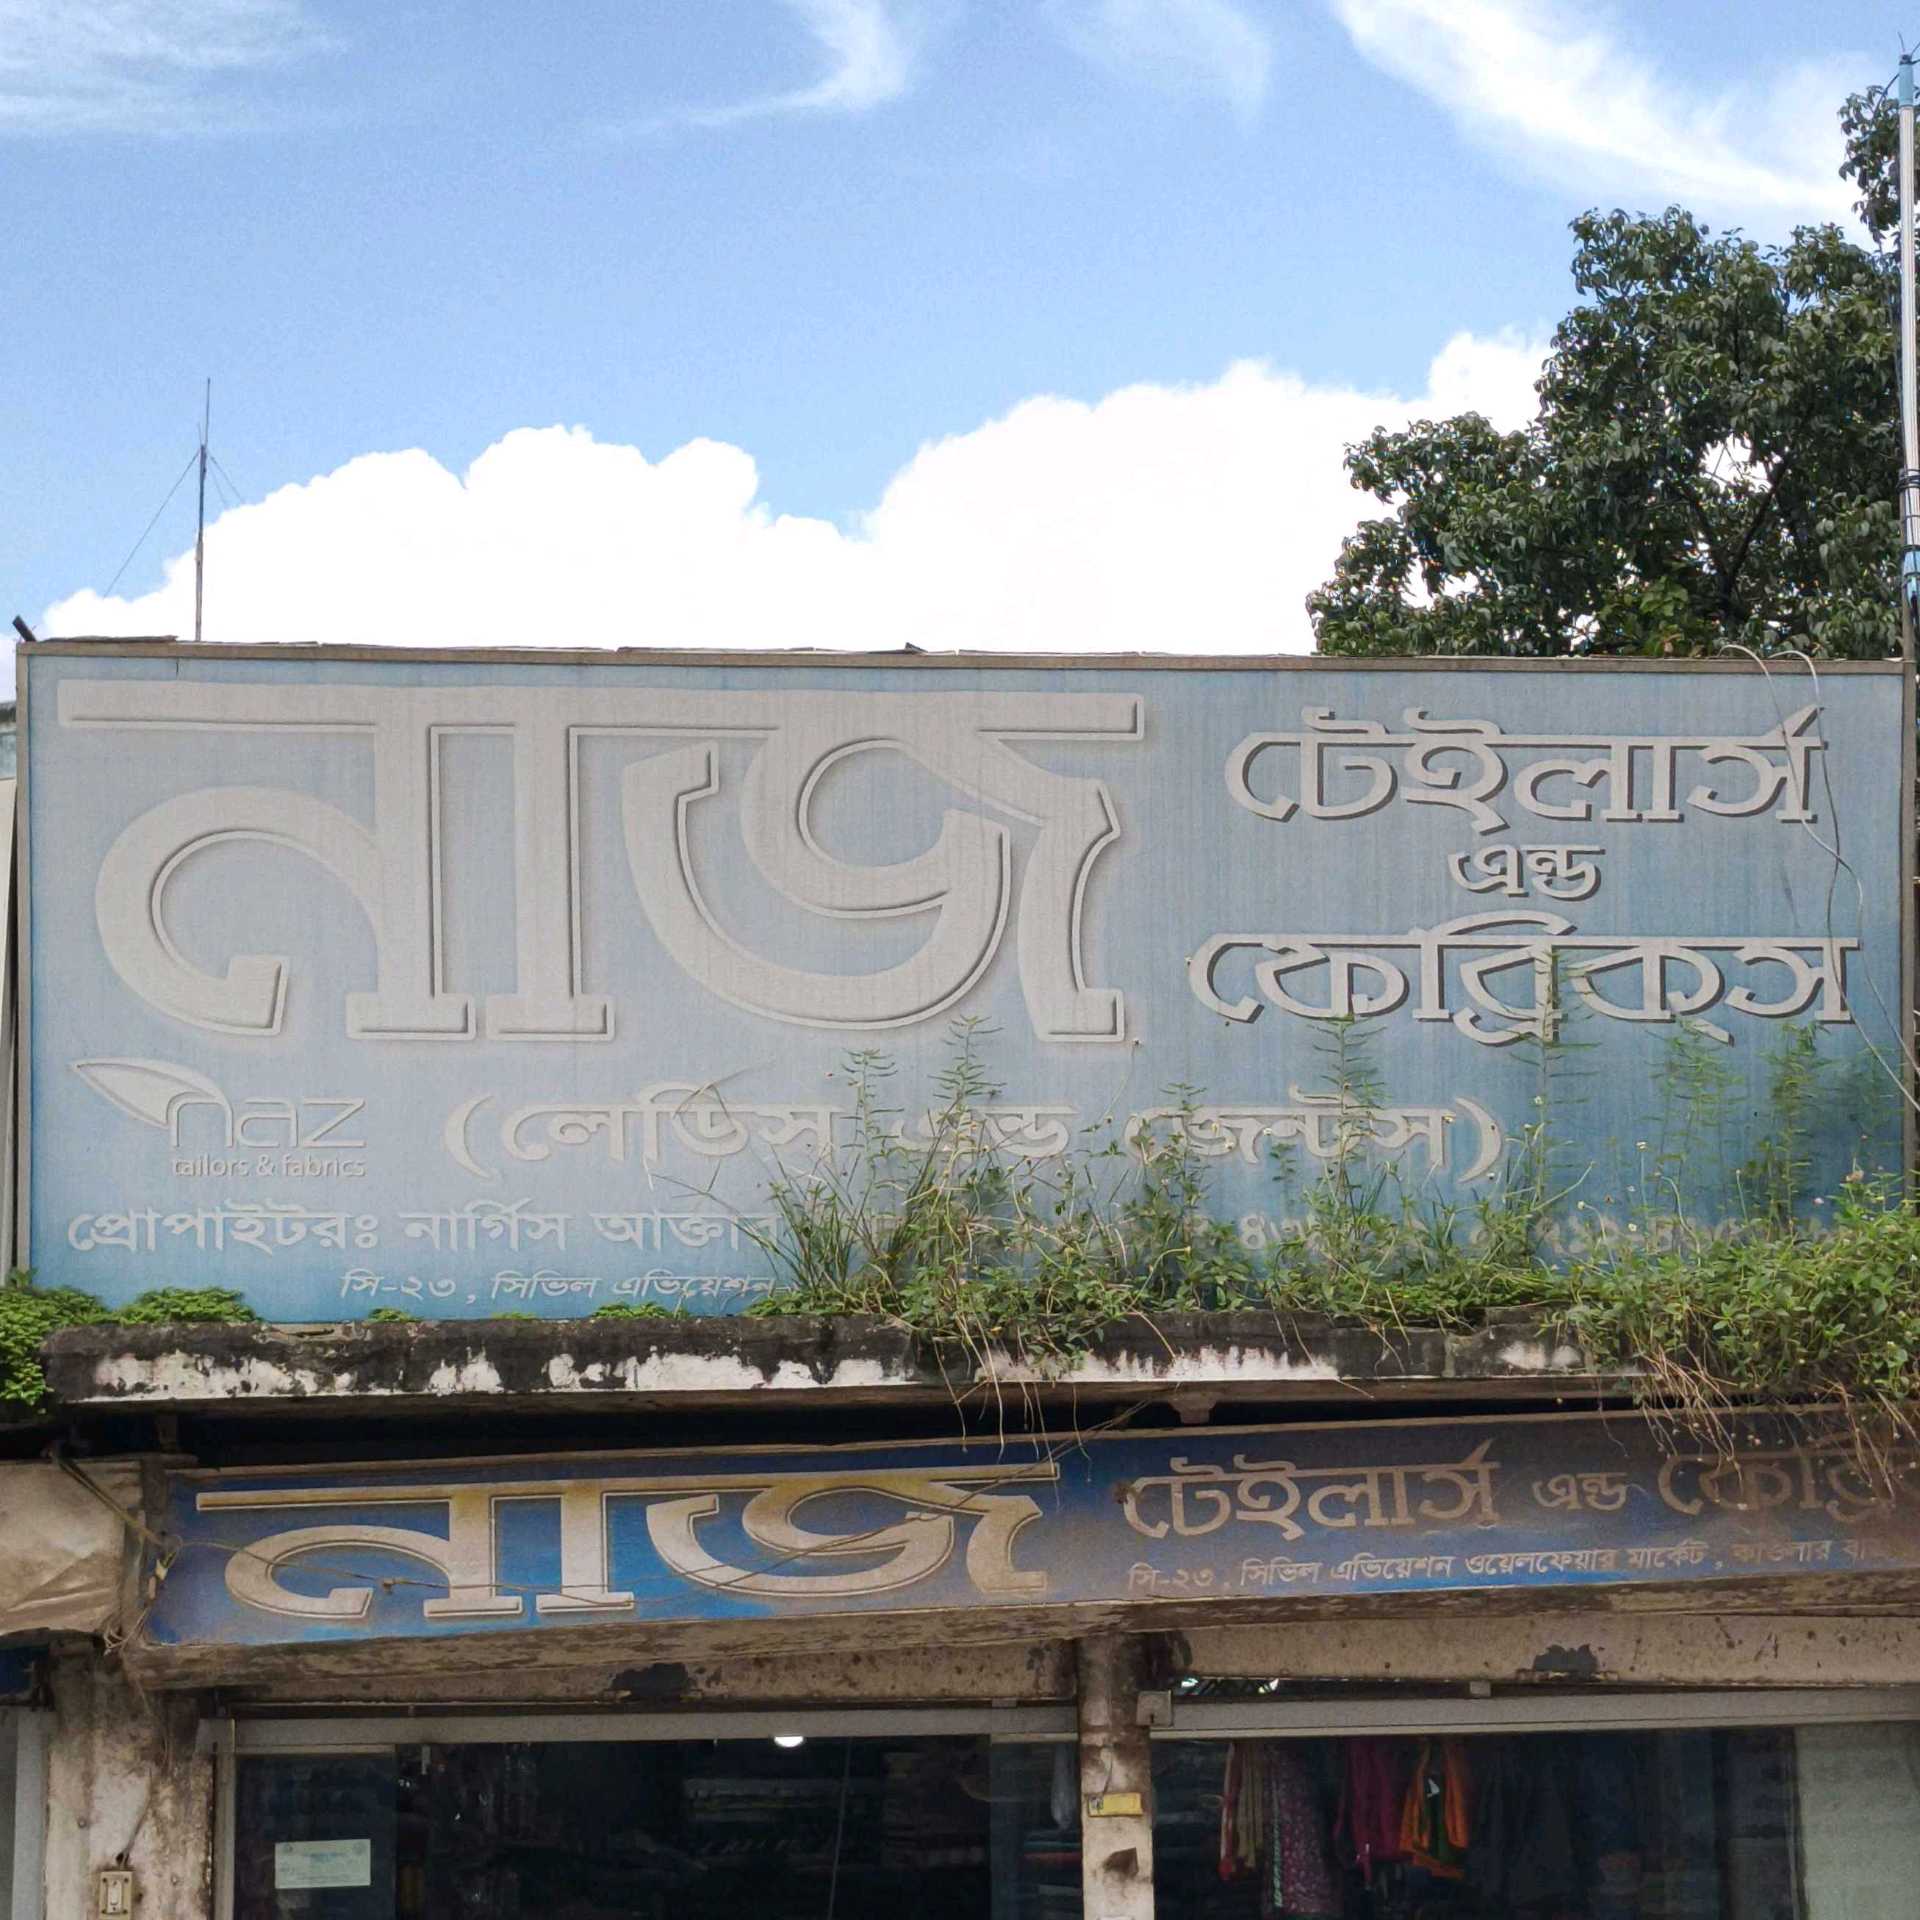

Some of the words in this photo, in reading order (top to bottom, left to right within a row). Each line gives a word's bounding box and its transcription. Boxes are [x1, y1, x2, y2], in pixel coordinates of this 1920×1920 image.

[1224, 704, 1828, 835] টেইলার্স
[58, 679, 1145, 1042] নাজ
[1447, 842, 1606, 900] এন্ড
[166, 1090, 368, 1149] naz
[172, 1153, 250, 1178] tailors
[257, 1154, 276, 1177] &
[281, 1153, 367, 1178] fabrics
[399, 1197, 572, 1252] নার্গিস
[491, 1267, 601, 1301] সিভিল
[196, 1461, 1060, 1619] নাজ
[1123, 1437, 1501, 1542] টেইলার্স
[1532, 1471, 1628, 1512] এন্ড
[1239, 1557, 1323, 1587] সিভিল
[1330, 1552, 1456, 1582] এভিয়েশন
